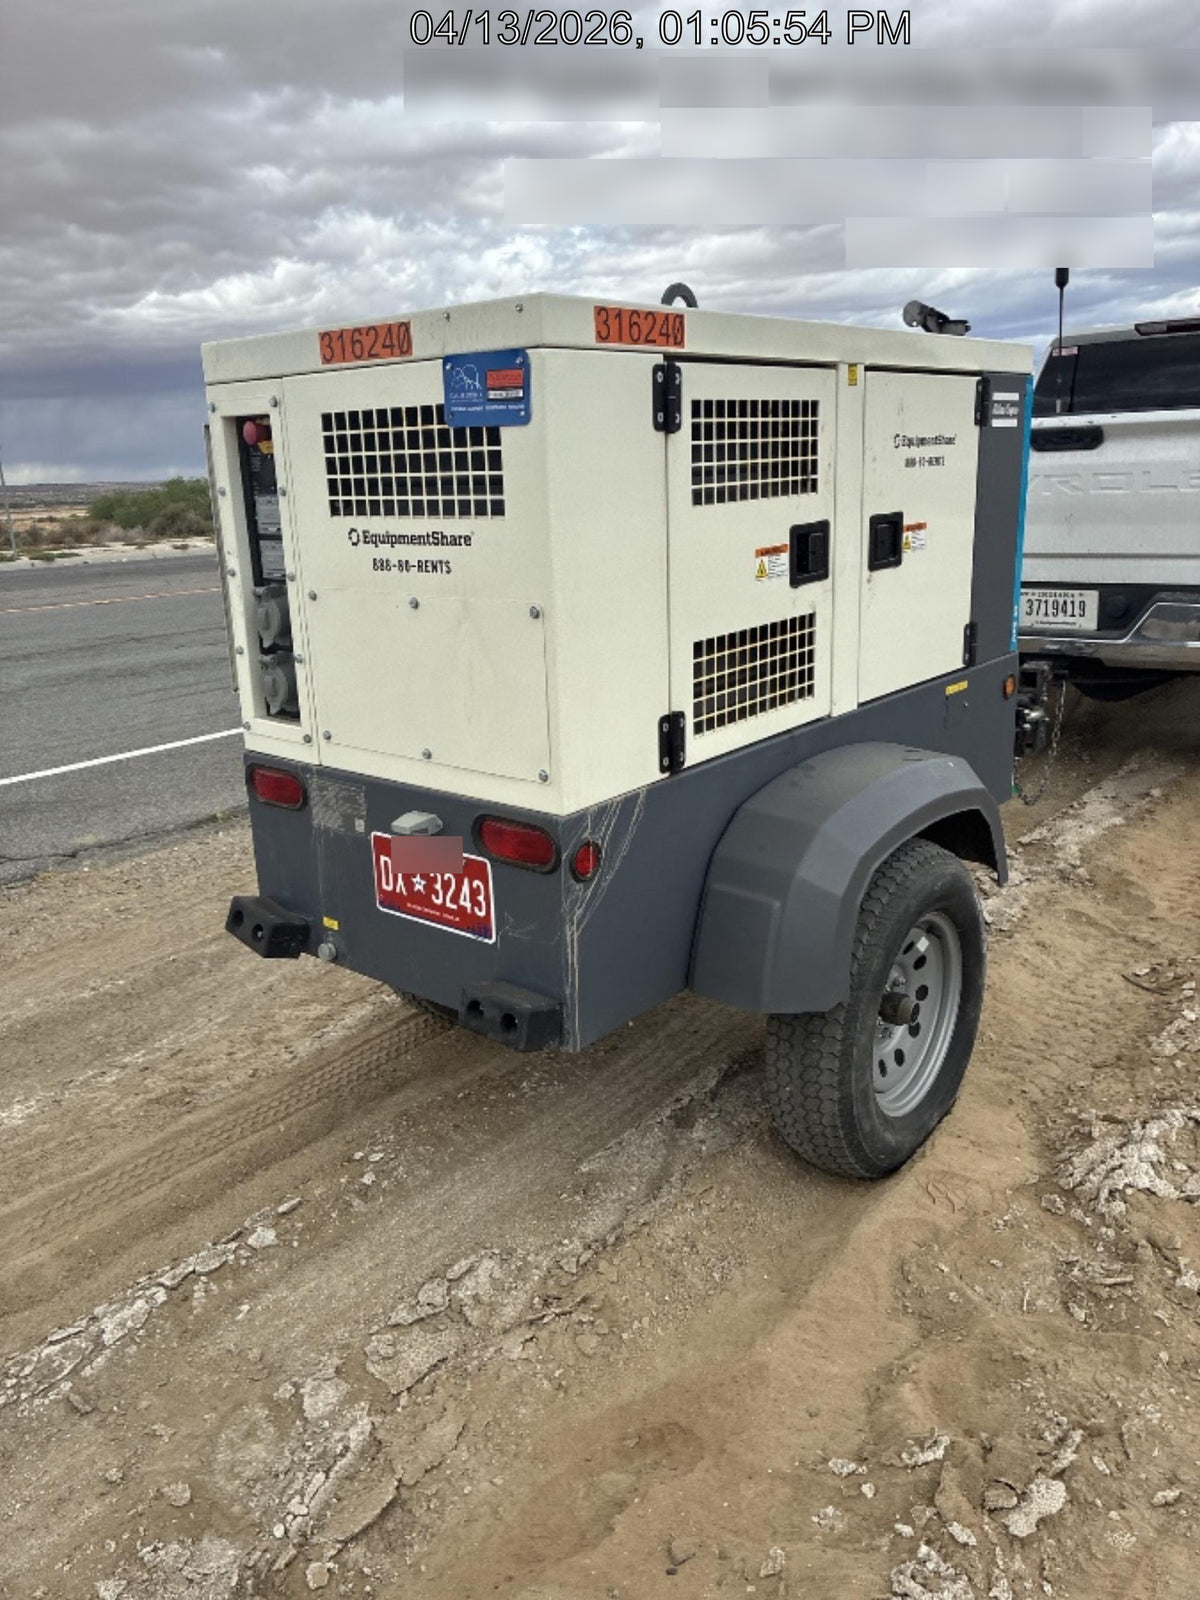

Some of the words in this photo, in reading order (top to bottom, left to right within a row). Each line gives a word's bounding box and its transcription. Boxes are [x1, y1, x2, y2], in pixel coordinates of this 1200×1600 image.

[321, 322, 410, 363] 316240
[597, 307, 684, 346] 316240
[362, 529, 472, 548] EquipmentShare
[1025, 599, 1086, 618] 3719419
[429, 870, 487, 918] 3243
